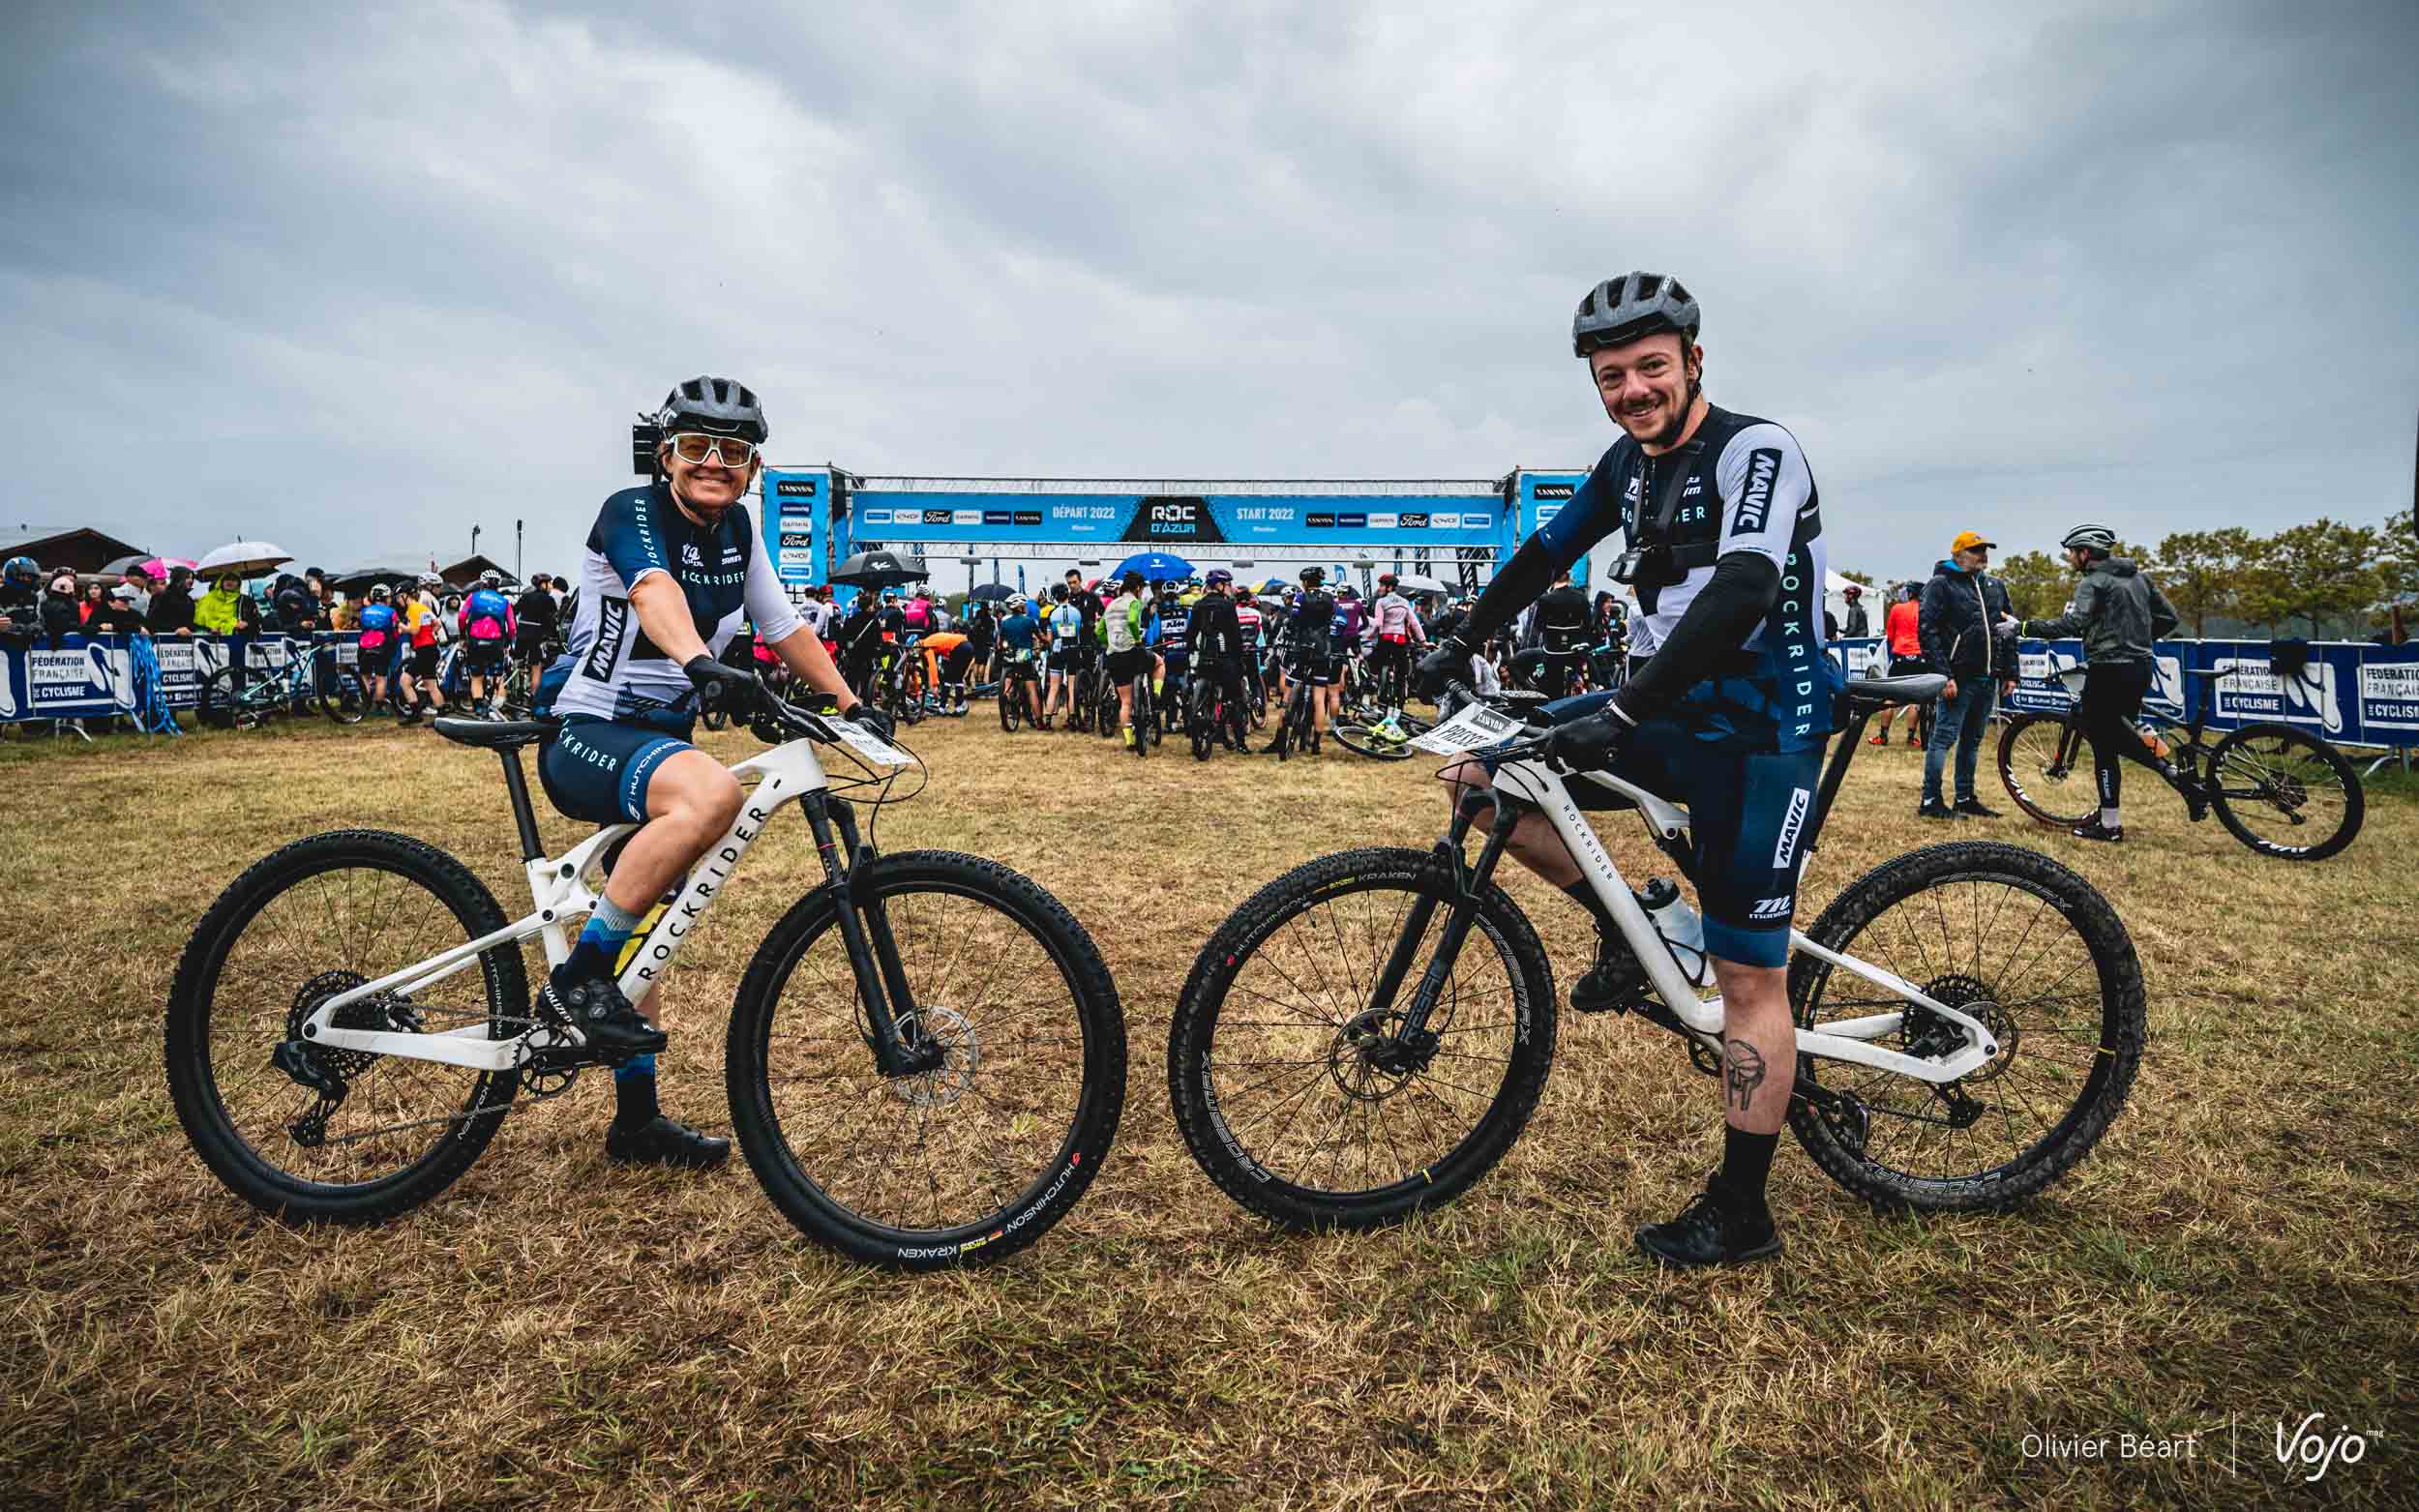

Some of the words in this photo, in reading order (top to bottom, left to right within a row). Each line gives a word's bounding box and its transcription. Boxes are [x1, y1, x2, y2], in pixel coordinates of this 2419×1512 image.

[1738, 452, 1776, 528] MAVIC
[924, 511, 950, 522] Ford
[1053, 503, 1088, 519] DÉPART
[1090, 506, 1116, 519] 2022
[1151, 504, 1196, 520] ROC
[1237, 507, 1266, 519] START
[1269, 507, 1294, 520] 2022
[1400, 515, 1427, 526] Ford
[782, 534, 810, 547] Ford
[592, 600, 623, 678] MAVIC
[41, 685, 85, 697] CYCLISME
[2223, 678, 2277, 691] FRANÇAISE
[2231, 697, 2280, 711] CYCLISME
[1478, 713, 1505, 731] CANYON
[1778, 793, 1806, 864] MAVIC
[1564, 804, 1613, 880] ROCKRIDER
[1358, 872, 1418, 882] KRAKEN
[638, 807, 767, 981] ROCKRIDER
[1006, 1162, 1075, 1233] HUTCHINSON
[898, 1245, 957, 1258] KRAKEN
